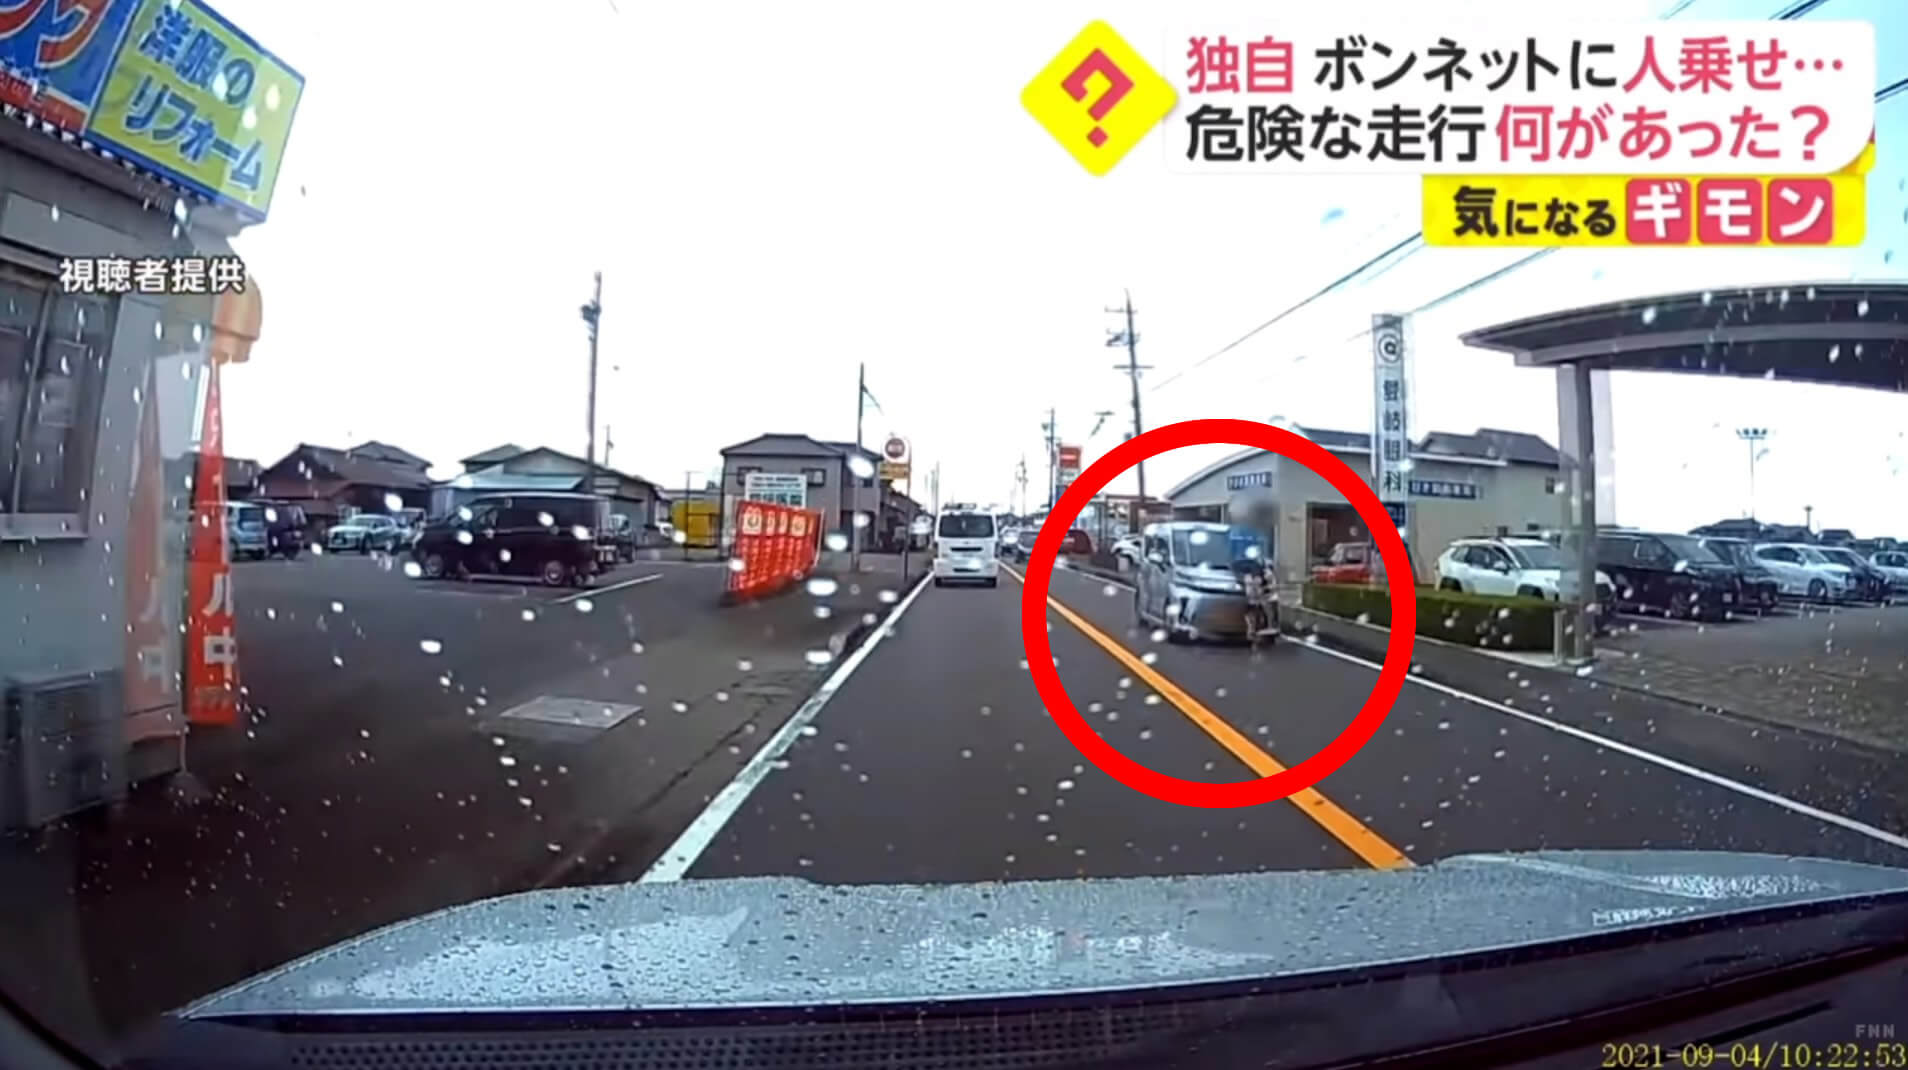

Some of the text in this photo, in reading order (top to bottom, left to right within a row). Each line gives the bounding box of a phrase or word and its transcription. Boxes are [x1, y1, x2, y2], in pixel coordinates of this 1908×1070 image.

[139, 4, 256, 105] 洋服の
[124, 74, 263, 191] リフォーム
